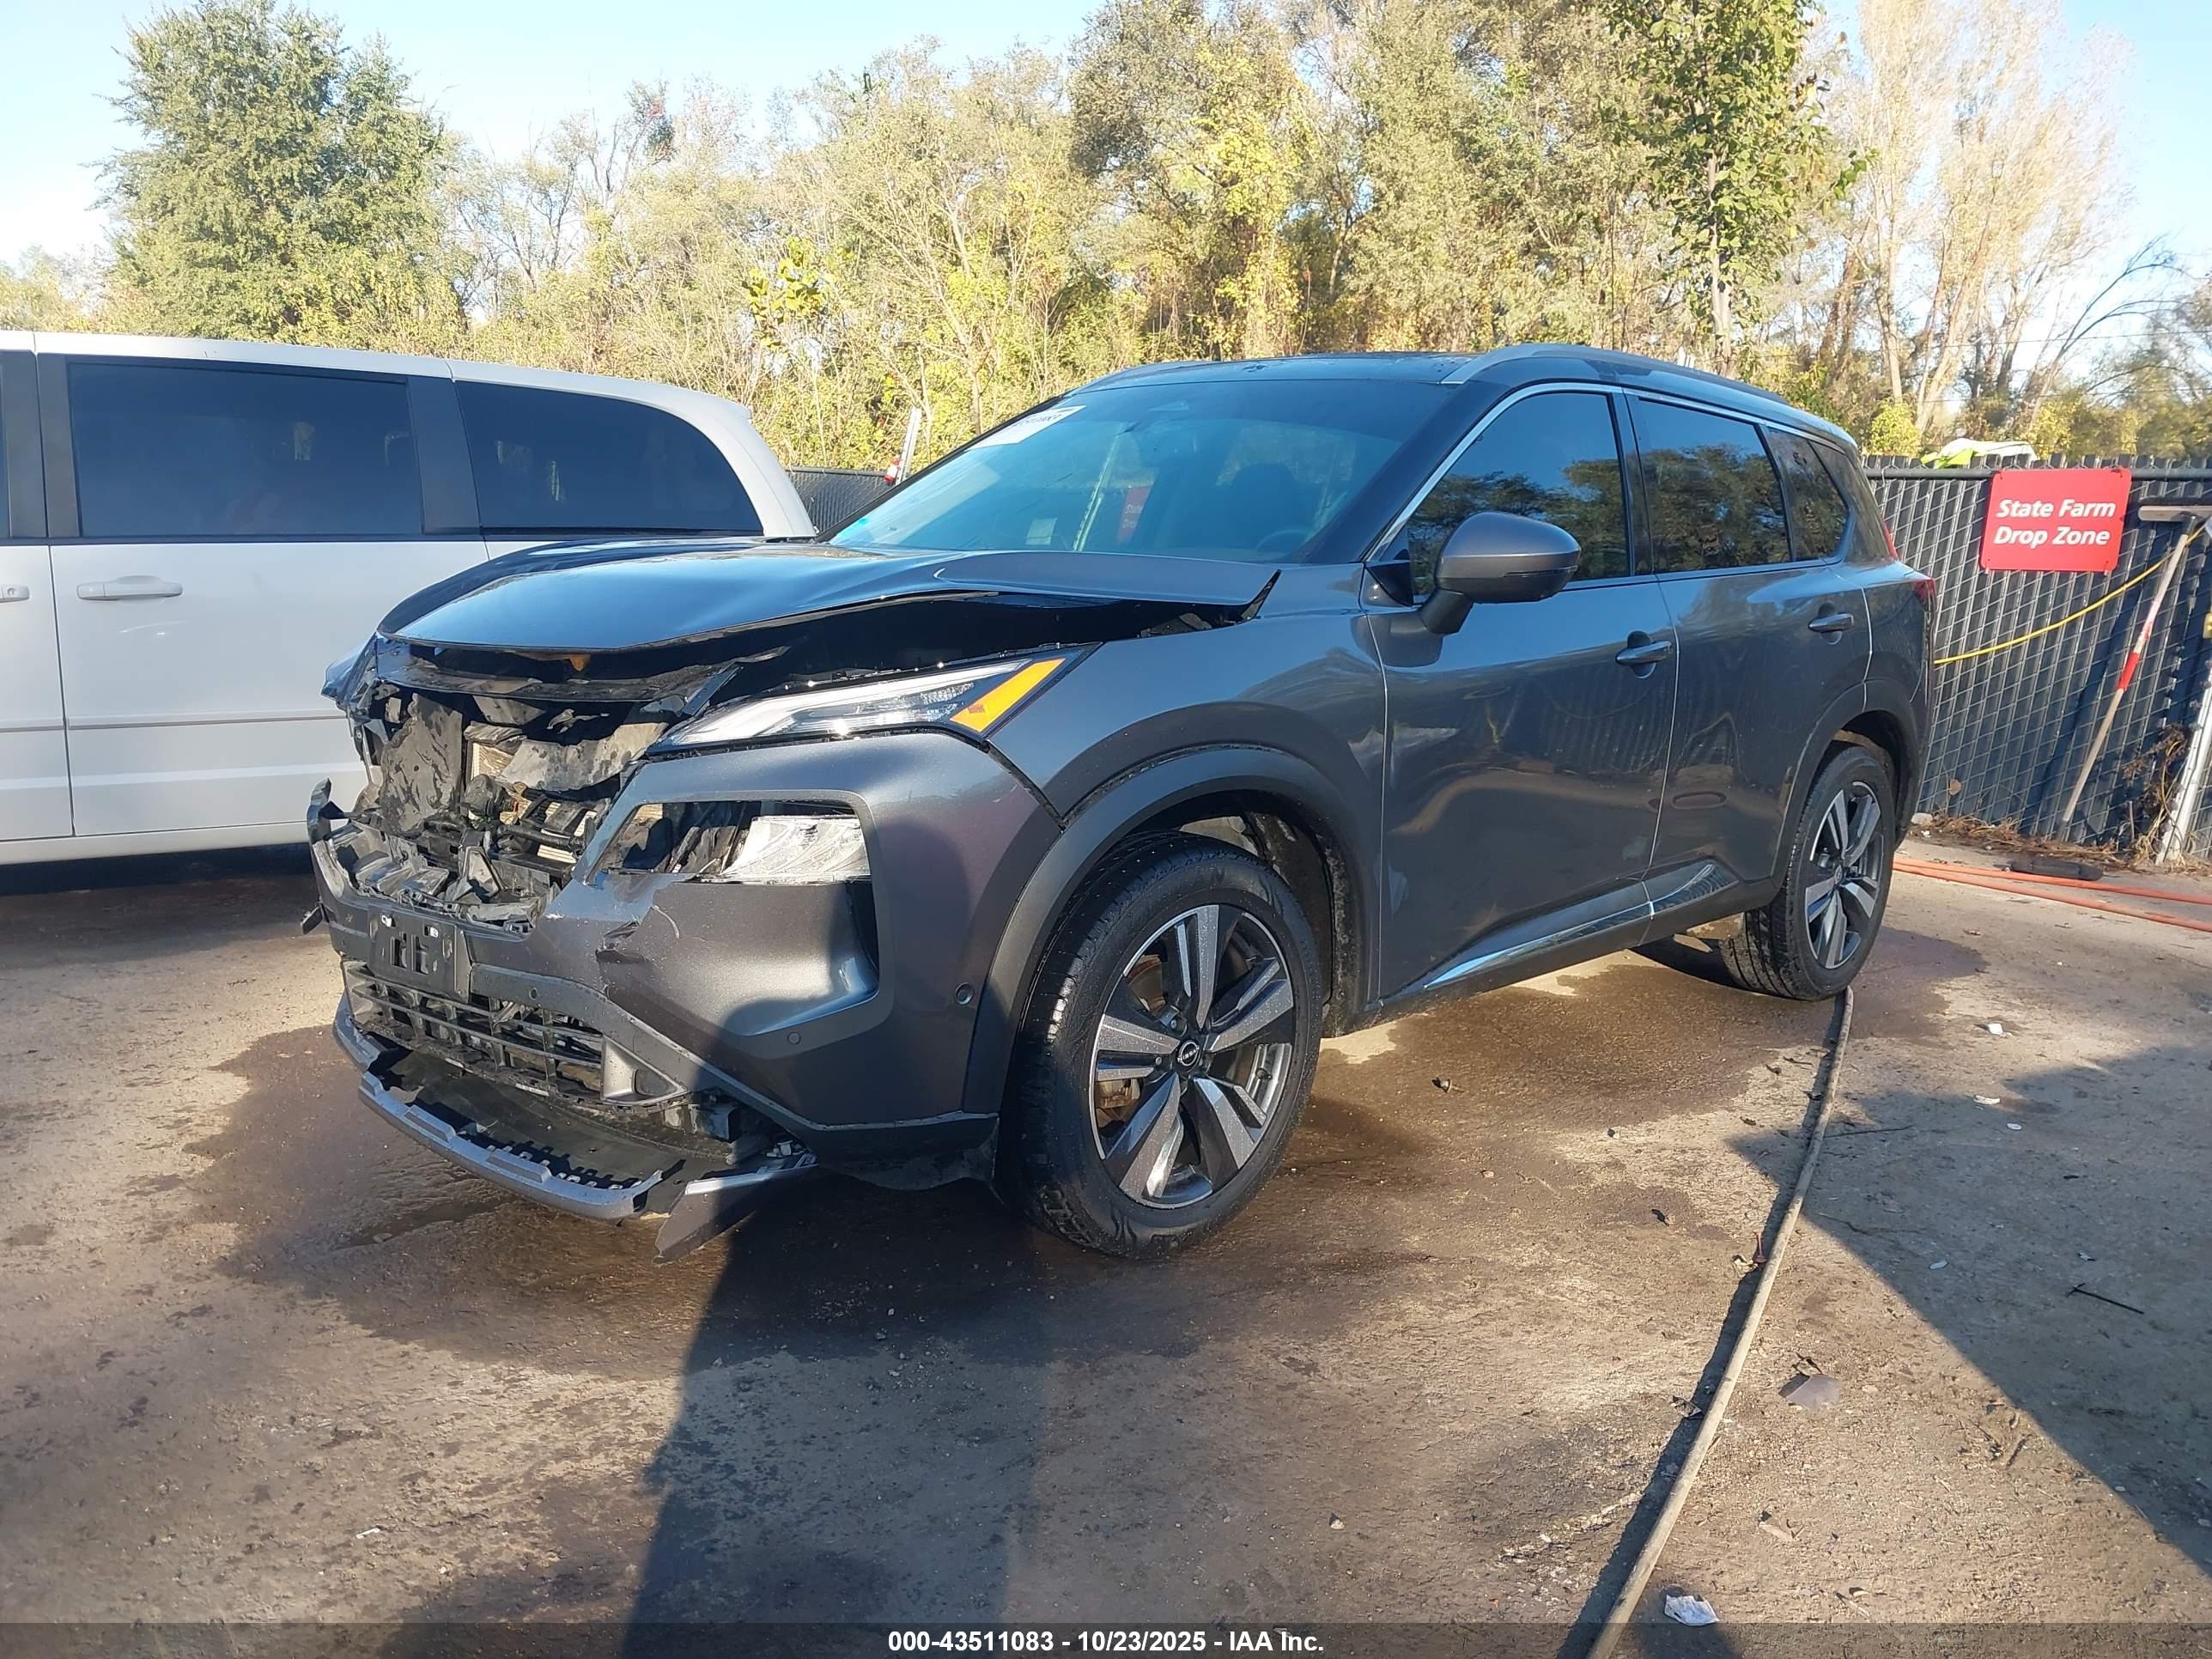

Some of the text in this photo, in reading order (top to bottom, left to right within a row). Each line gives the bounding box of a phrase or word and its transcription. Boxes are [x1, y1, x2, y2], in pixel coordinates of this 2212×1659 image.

[1995, 499, 2117, 518] State Farm
[1993, 526, 2111, 550] Drop Zone
